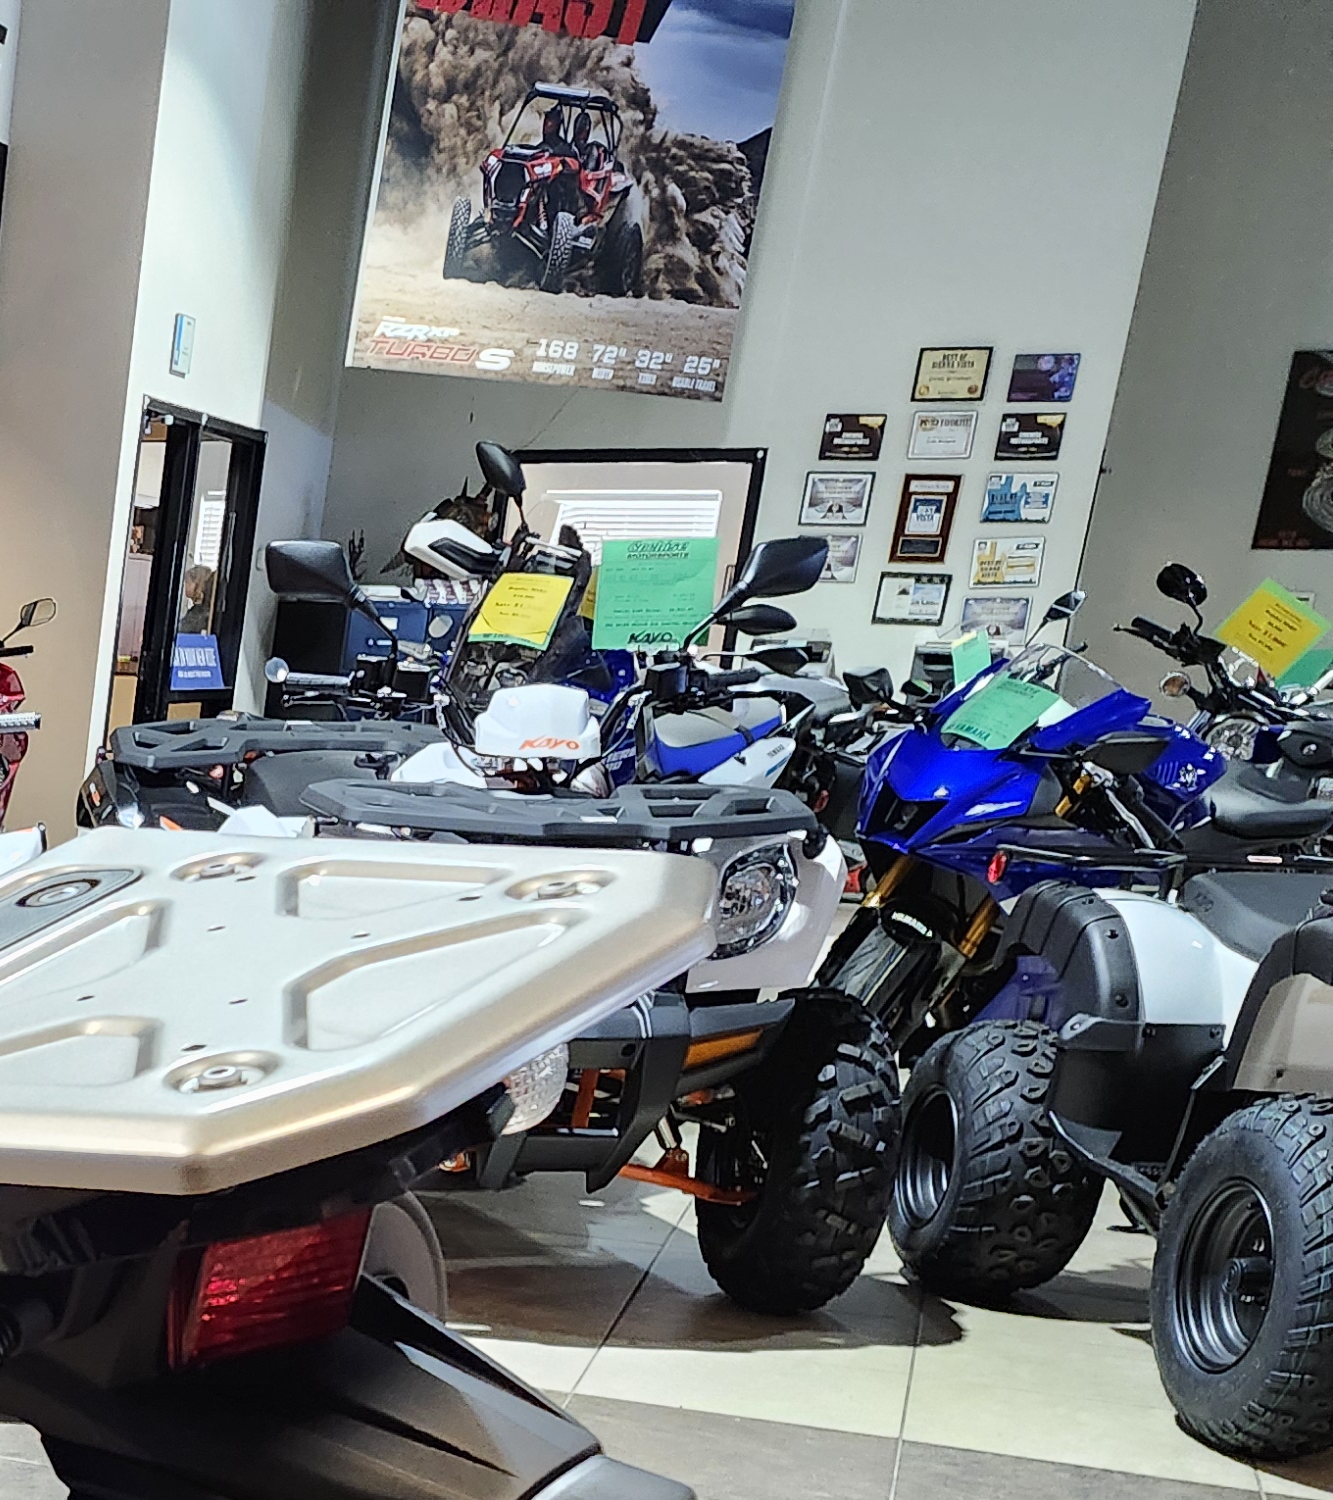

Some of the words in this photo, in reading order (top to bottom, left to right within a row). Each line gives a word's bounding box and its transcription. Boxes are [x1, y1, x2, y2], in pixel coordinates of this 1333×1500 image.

[366, 336, 479, 364] TURBO
[474, 347, 516, 371] S
[536, 338, 580, 360] 168
